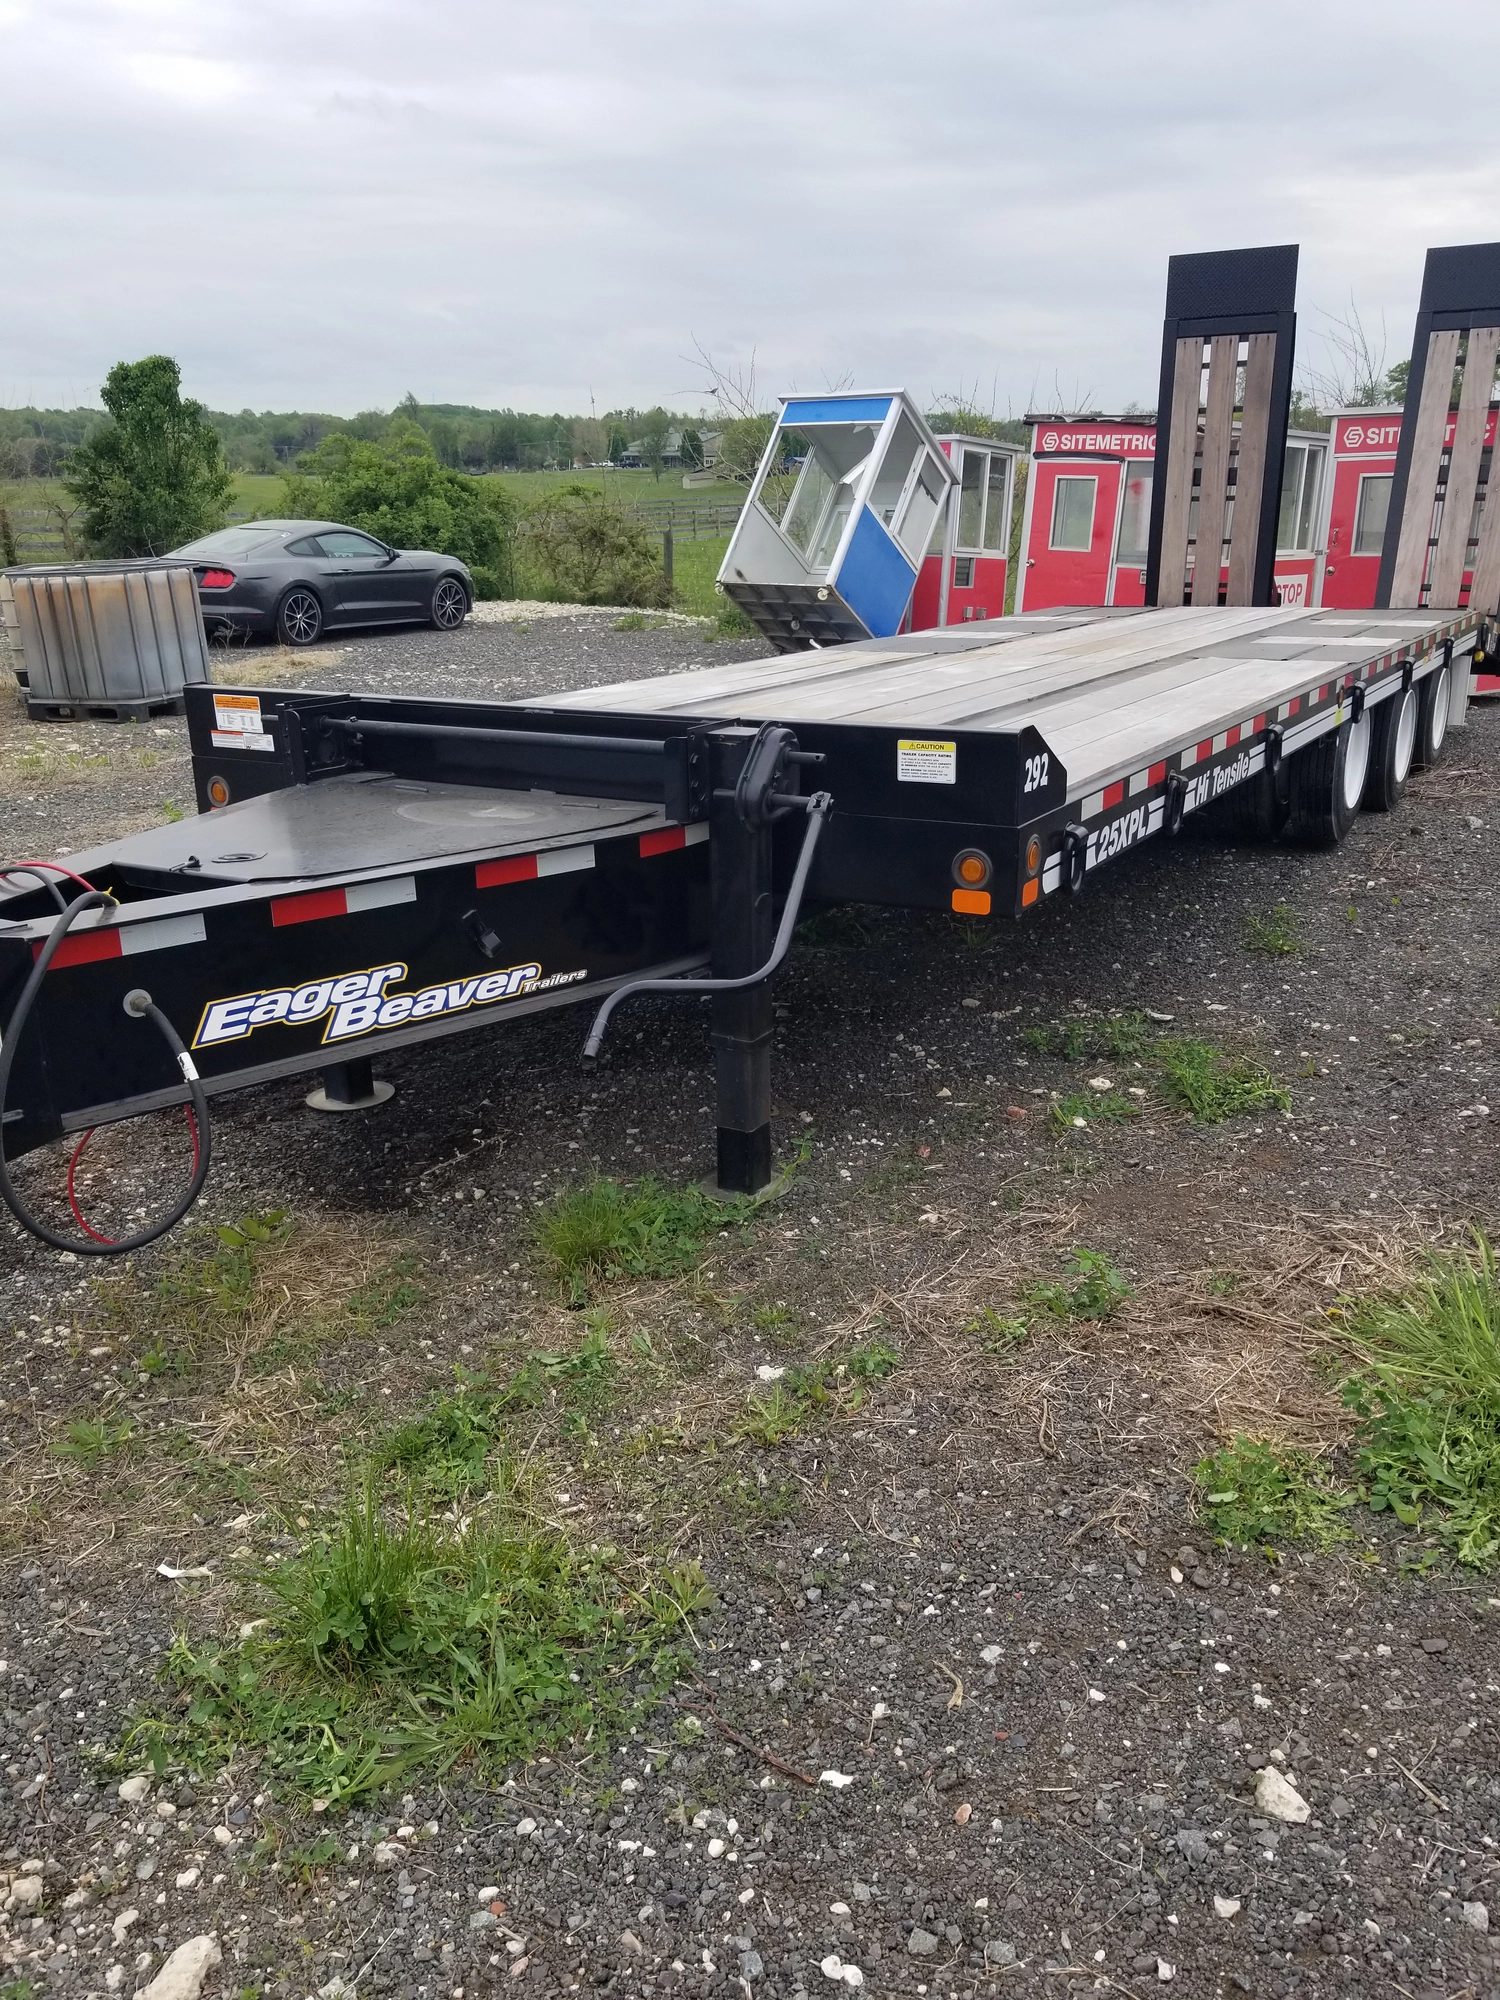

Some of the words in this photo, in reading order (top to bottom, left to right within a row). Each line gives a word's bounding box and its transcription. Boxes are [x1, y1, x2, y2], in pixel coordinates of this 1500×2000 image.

[1024, 752, 1049, 793] 292
[1195, 769, 1211, 806] Hi
[1212, 752, 1249, 797] Tensile
[1096, 805, 1147, 863] 25XPL
[195, 964, 406, 1047] Eager
[325, 964, 540, 1042] Beaver
[522, 969, 588, 993] Trailers
